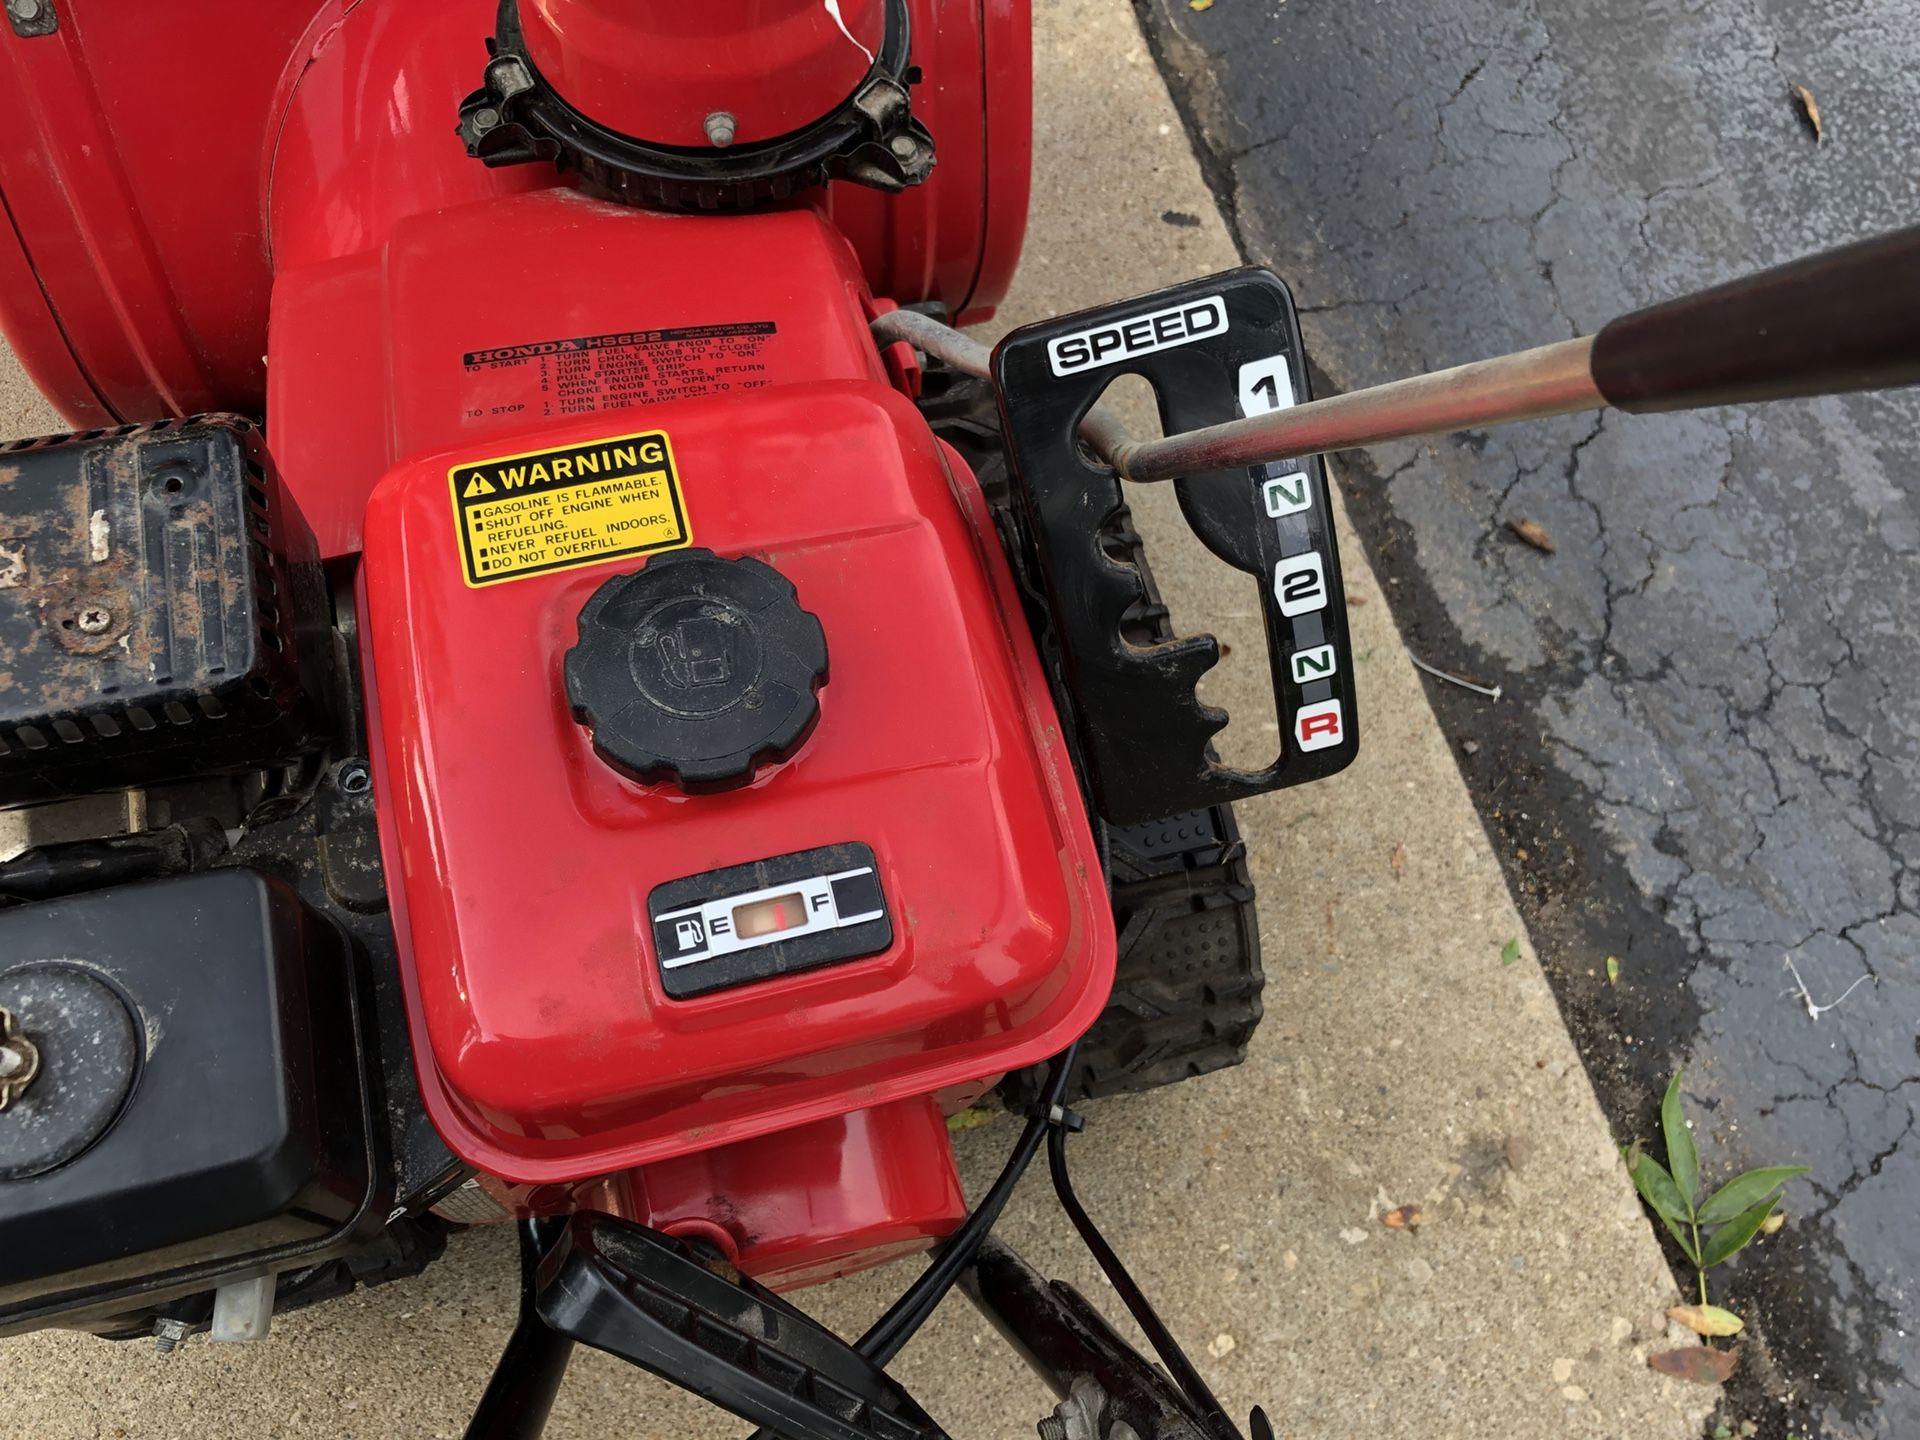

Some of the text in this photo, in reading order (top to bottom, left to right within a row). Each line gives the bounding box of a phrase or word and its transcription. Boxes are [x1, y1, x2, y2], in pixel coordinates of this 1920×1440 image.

[1056, 303, 1220, 369] SPEED
[472, 341, 579, 363] HONDA
[490, 358, 530, 370] START
[556, 351, 590, 361] TURN
[597, 347, 626, 356] FUEL
[634, 343, 670, 352] VALVE
[677, 339, 712, 348] KNOB
[556, 358, 590, 368] TURN
[598, 353, 640, 362] CHOKE
[648, 349, 682, 357] KNOB
[557, 365, 591, 375] TURN
[598, 360, 645, 370] ENGINE
[652, 356, 700, 364] SWITCH
[709, 352, 724, 360] TO
[557, 374, 588, 382] PULL
[594, 366, 648, 378] STARTER
[656, 363, 690, 372] GRIP.
[558, 380, 596, 390] WHEN
[604, 374, 650, 384] ENGINE
[716, 364, 765, 374] RETURN
[466, 410, 483, 418] TO
[492, 404, 526, 415] STOP
[560, 396, 594, 406] TURN
[602, 390, 649, 401] ENGINE
[657, 386, 706, 396] SWITCH
[558, 386, 602, 397] CHOKE
[609, 382, 644, 391] KNOB
[1250, 375, 1278, 409] 1
[560, 404, 596, 414] TURN
[603, 400, 634, 410] FUEL
[498, 442, 664, 490] WARNING
[484, 476, 662, 518] GASOLINE IS FLAMMABLE.
[486, 489, 660, 530] SHUT OFF ENGINE WHEN
[1268, 478, 1306, 511] N
[488, 520, 568, 543] REFUELING.
[490, 513, 670, 556] NEVER REFUEL INDOORS.
[492, 536, 621, 570] DO NOT OVERFILL.
[1282, 568, 1321, 604] 2
[1296, 650, 1331, 678] N
[1300, 711, 1339, 742] R
[709, 892, 830, 936] E F
